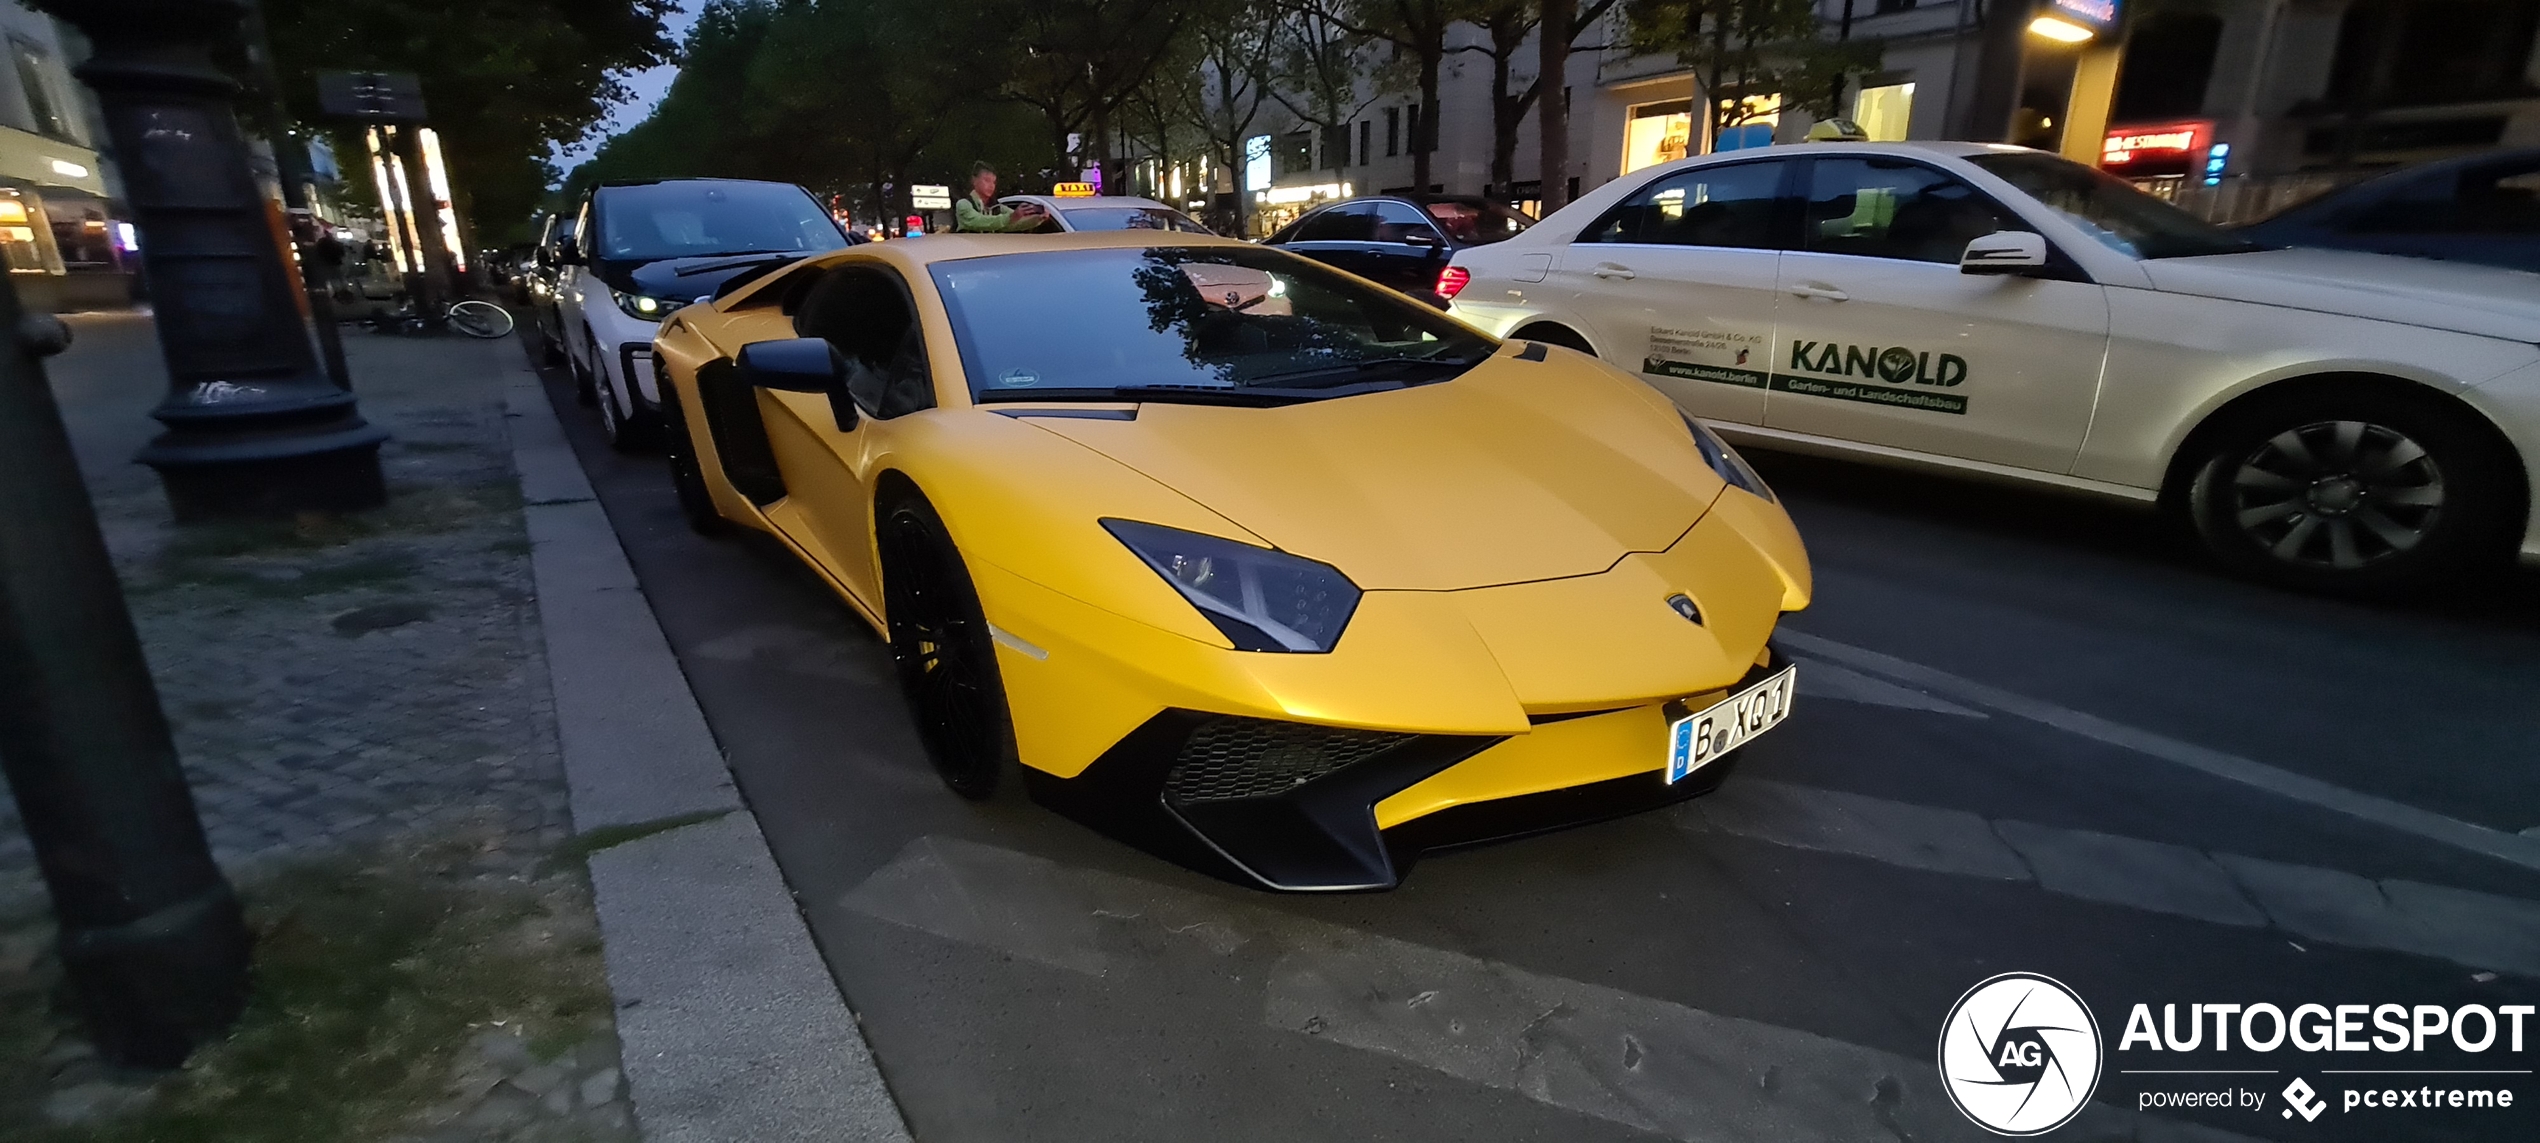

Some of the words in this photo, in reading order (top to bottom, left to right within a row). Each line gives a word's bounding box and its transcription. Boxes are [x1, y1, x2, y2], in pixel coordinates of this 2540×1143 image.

[1669, 366, 1758, 384] www.kanold.berlin
[1791, 340, 1967, 387] KANOLD
[1788, 379, 1830, 393] Garten-
[1833, 386, 1856, 396] und
[1859, 387, 1962, 410] Landschaftsbau
[1694, 716, 1714, 764] B
[1677, 755, 1685, 769] D
